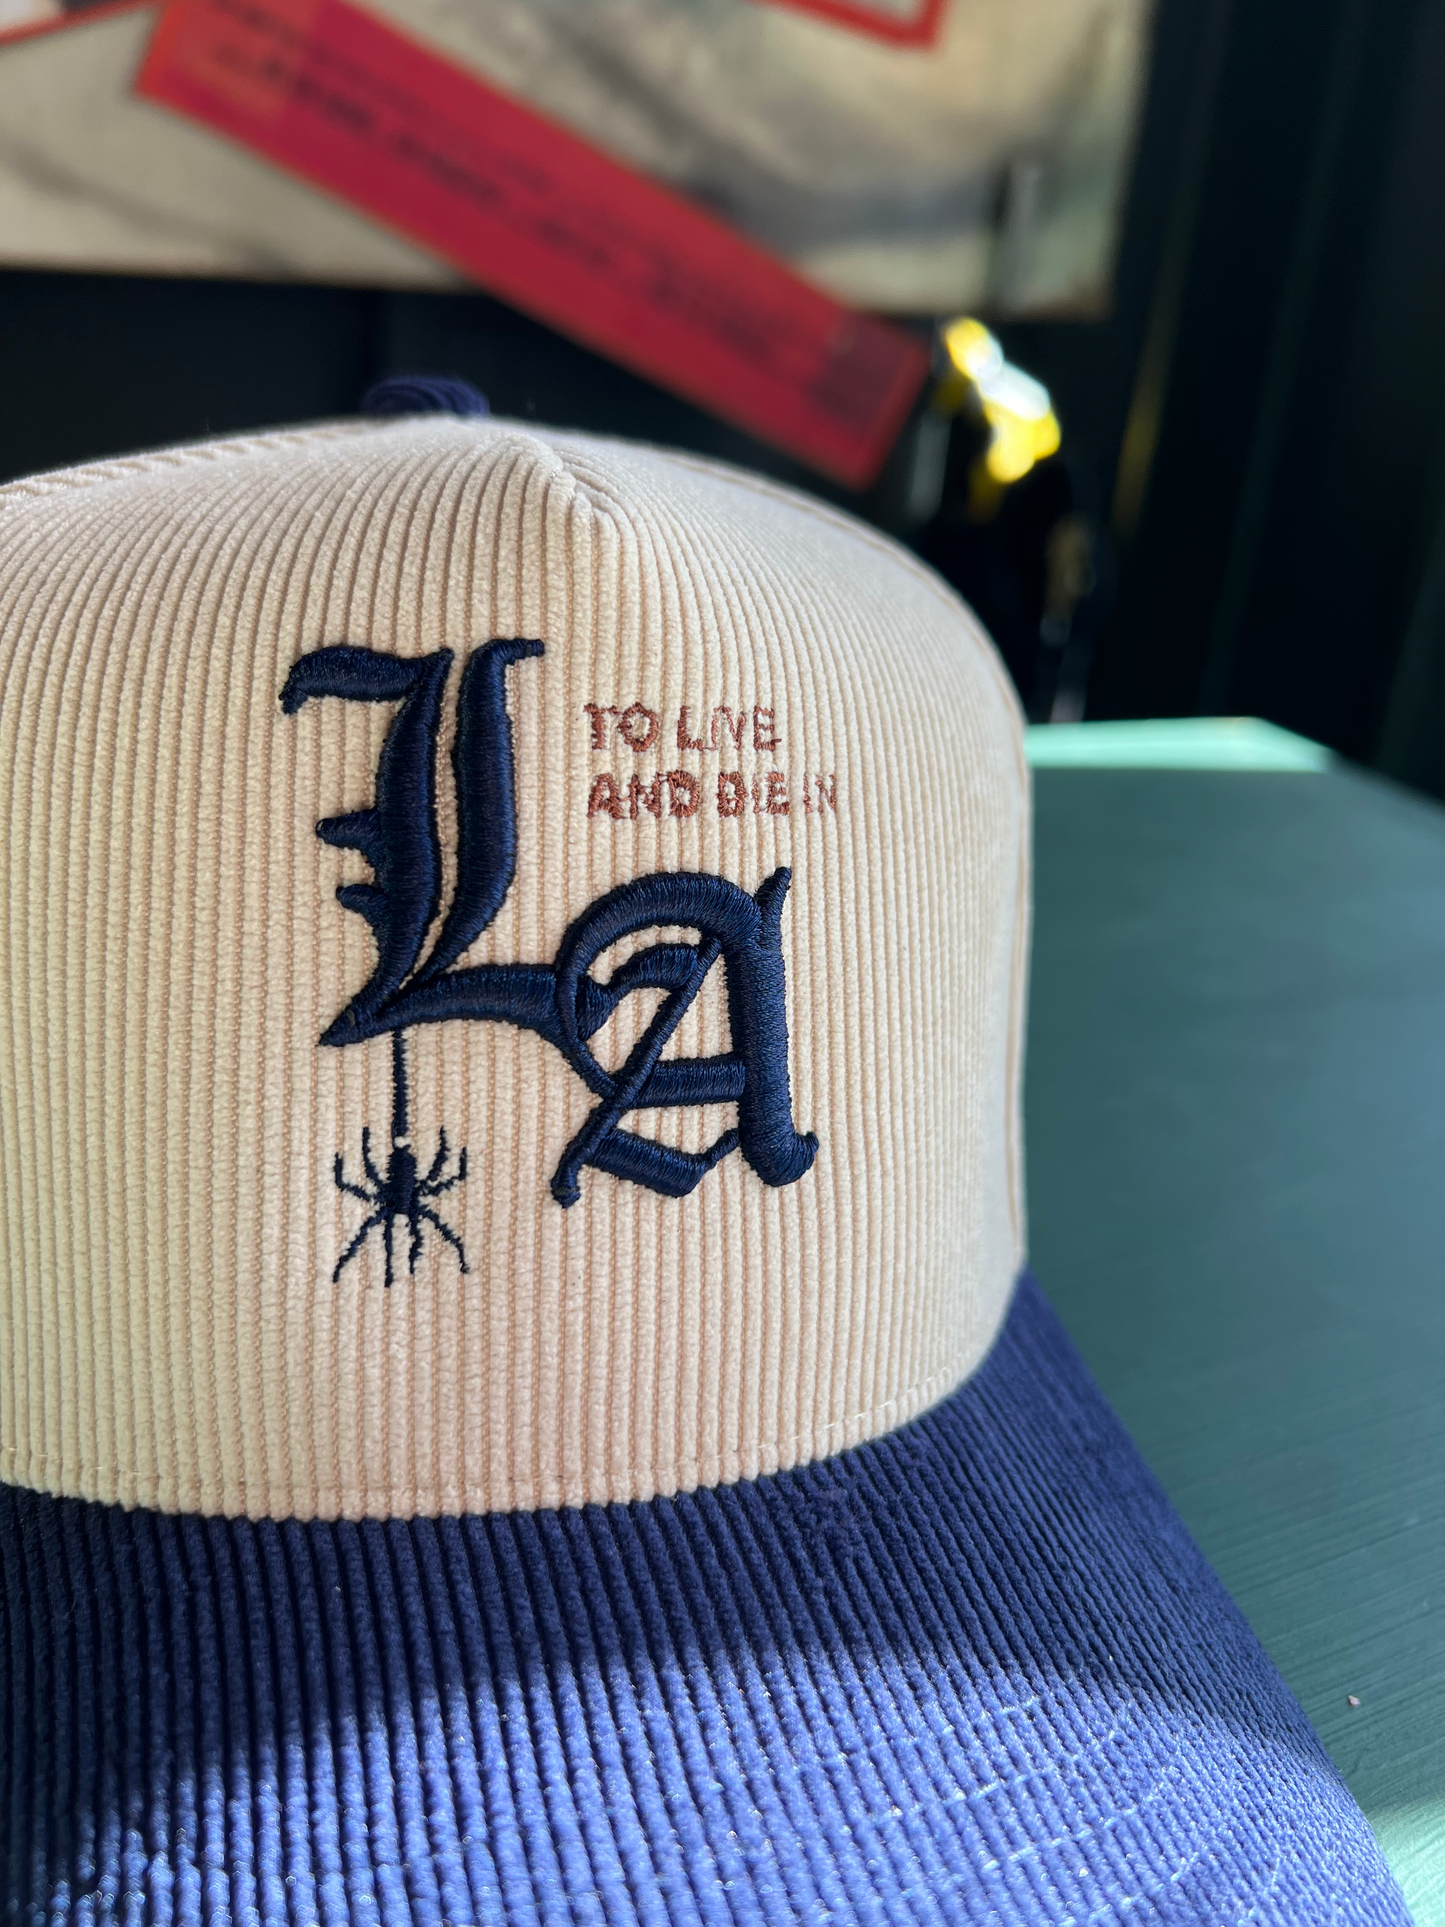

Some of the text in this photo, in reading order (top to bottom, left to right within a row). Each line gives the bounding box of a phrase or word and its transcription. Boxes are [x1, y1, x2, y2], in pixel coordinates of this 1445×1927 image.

[584, 702, 782, 751] TO LIVE
[587, 770, 836, 820] AND DIE IN
